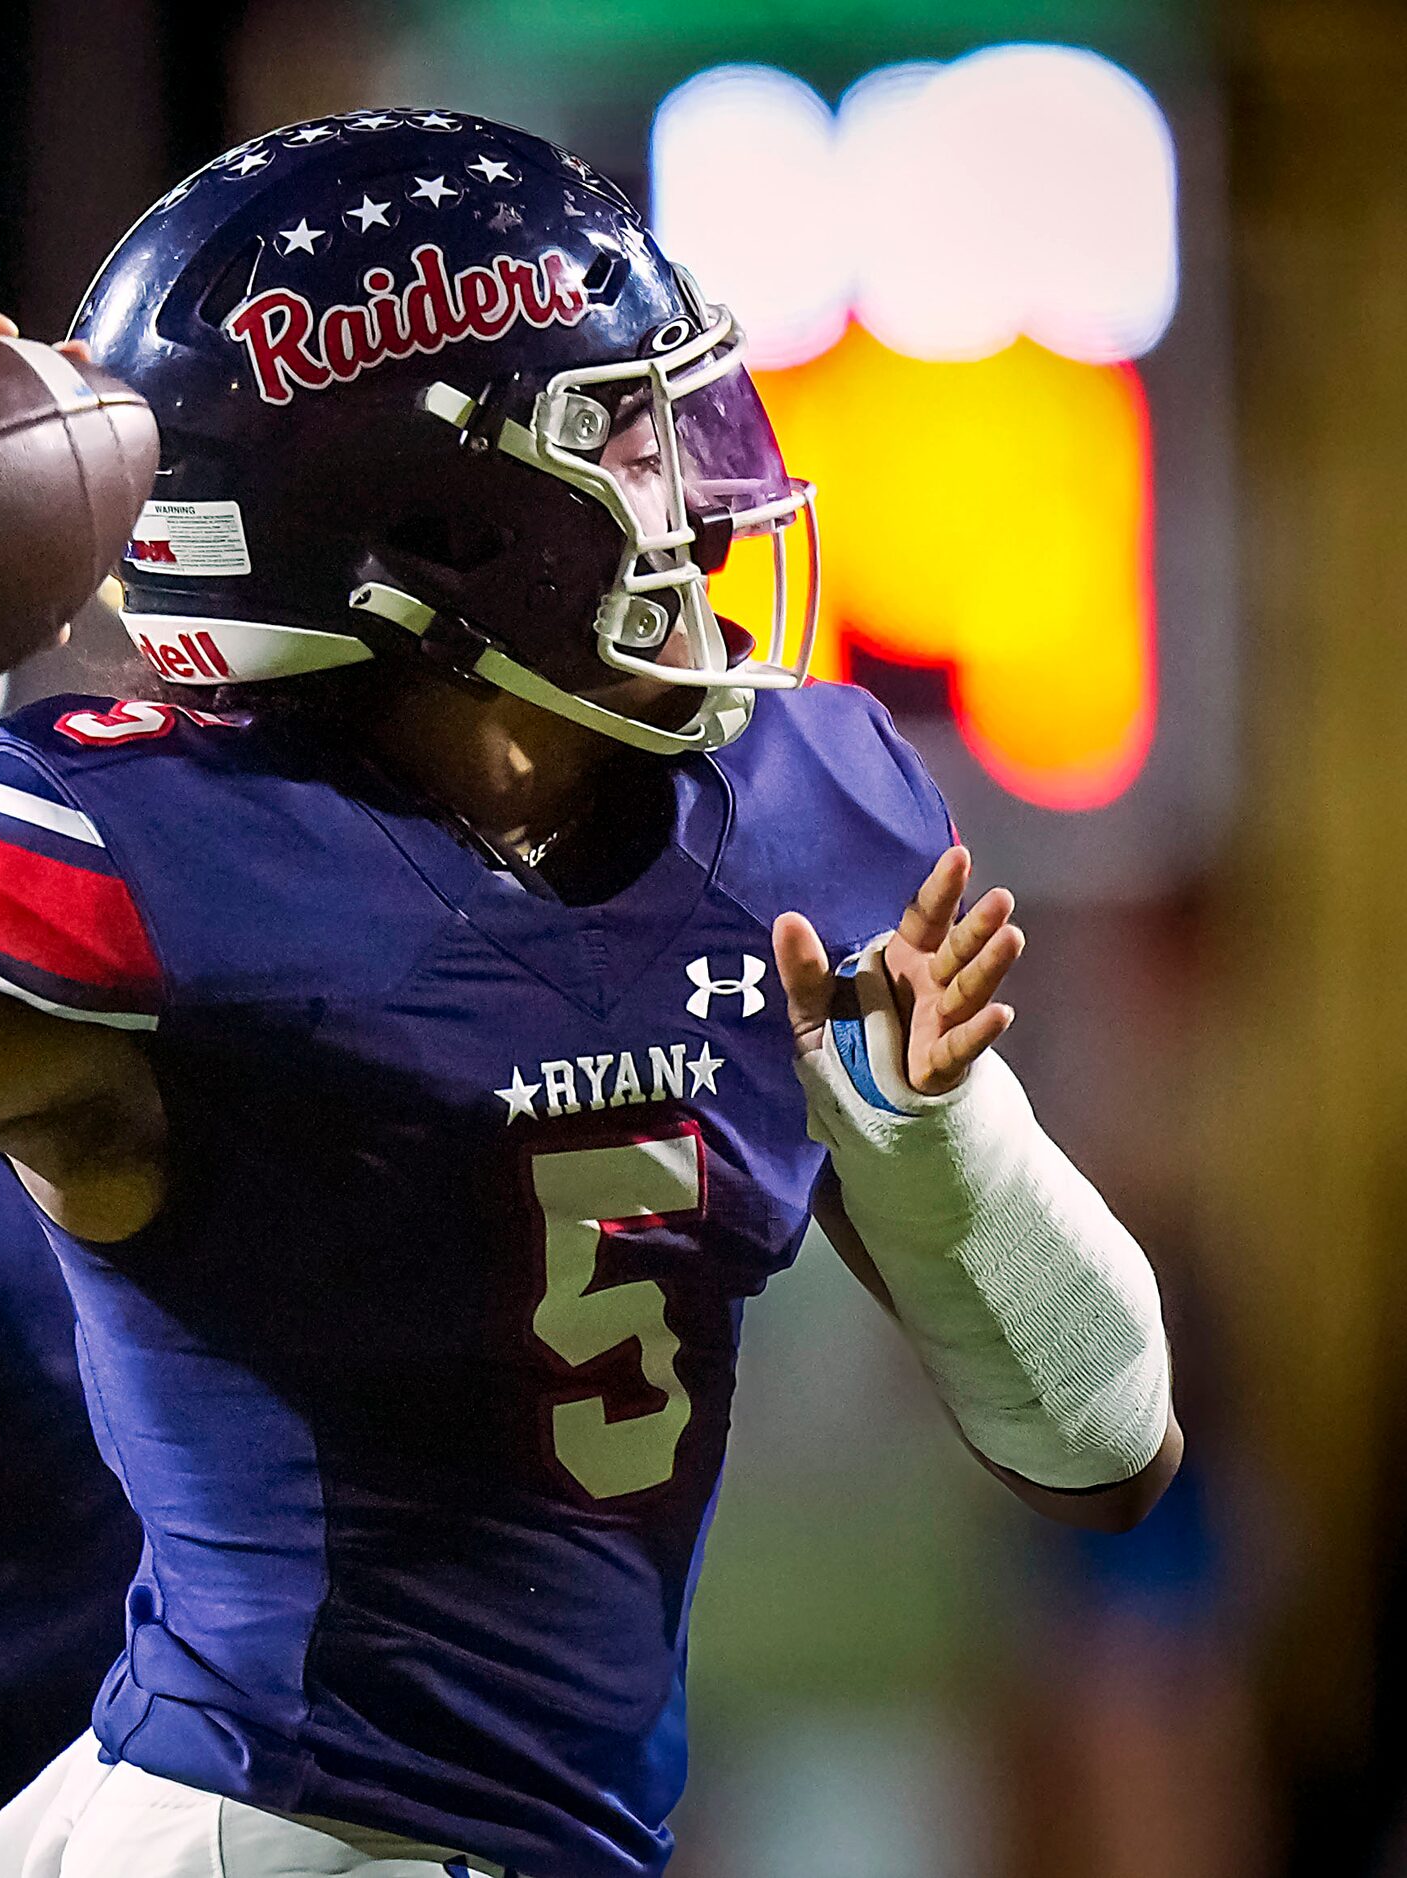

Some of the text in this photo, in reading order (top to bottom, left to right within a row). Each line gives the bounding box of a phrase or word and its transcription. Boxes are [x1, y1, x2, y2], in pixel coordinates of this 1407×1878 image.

[229, 244, 588, 405] Raiders
[154, 506, 196, 515] WARNING
[541, 1044, 687, 1117] RYAN
[531, 1132, 704, 1500] 5
